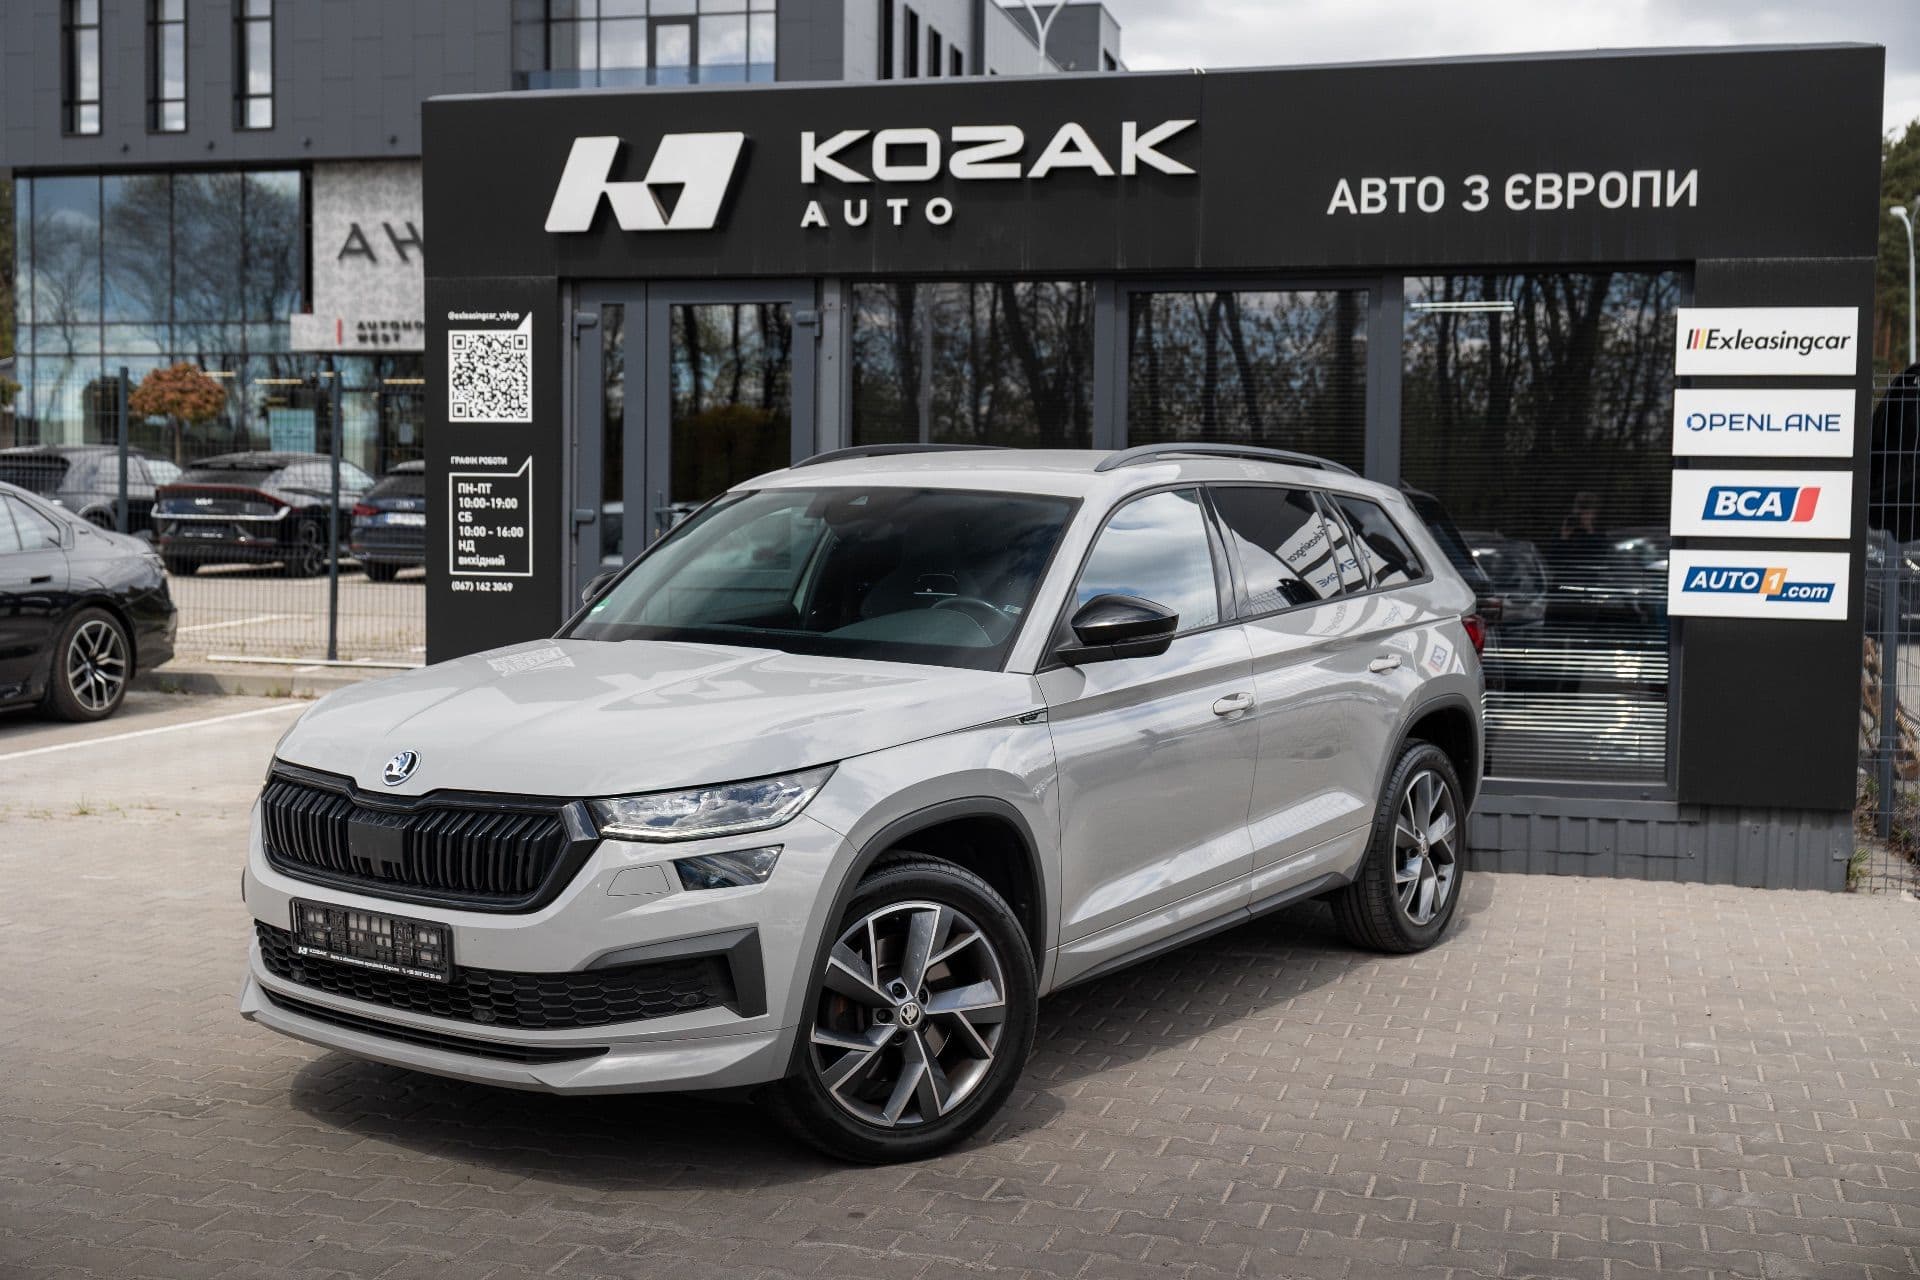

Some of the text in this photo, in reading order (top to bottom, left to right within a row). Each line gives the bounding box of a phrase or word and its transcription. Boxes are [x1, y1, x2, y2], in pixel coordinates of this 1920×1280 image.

[801, 119, 1196, 184] KOZAK
[1327, 176, 1445, 214] АВТО
[1504, 169, 1698, 210] ЄВРОПИ
[801, 197, 953, 228] AUTO
[1705, 328, 1851, 356] Exleasingcar
[1686, 413, 1841, 432] OPENLANE
[479, 456, 508, 465] РОБОТИ
[458, 483, 492, 494] ПН-ПТ
[1714, 491, 1783, 517] BCA
[458, 511, 473, 522] СБ
[459, 526, 486, 537] 10:00
[496, 526, 524, 537] 16:00
[458, 540, 475, 553] НД
[451, 581, 474, 592] (067)
[476, 581, 491, 592] 162
